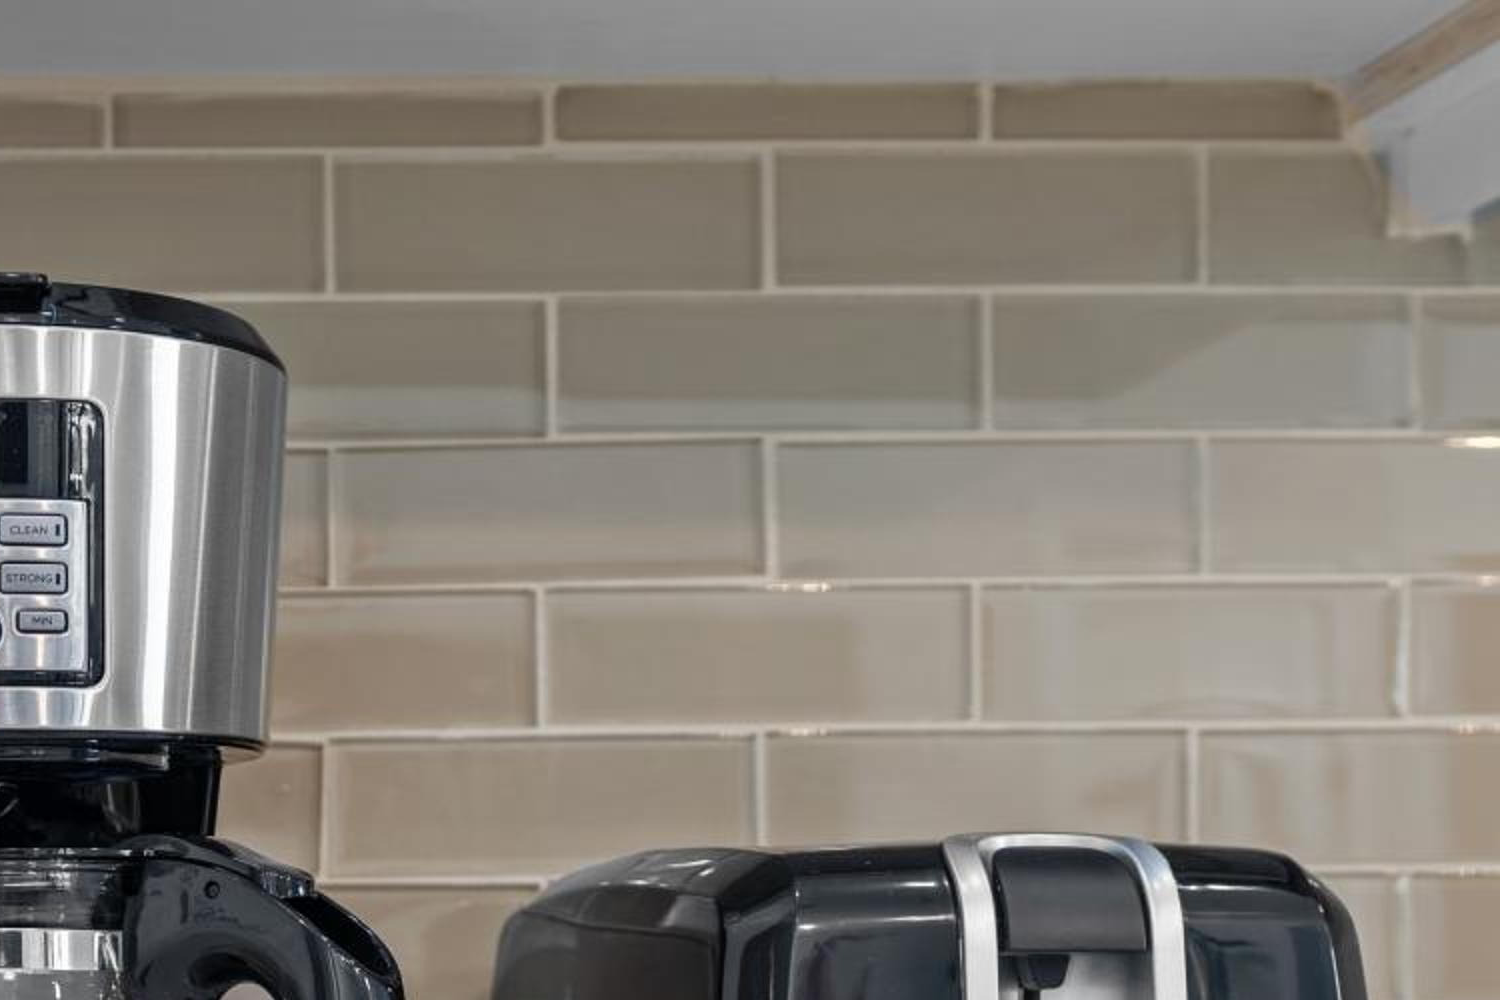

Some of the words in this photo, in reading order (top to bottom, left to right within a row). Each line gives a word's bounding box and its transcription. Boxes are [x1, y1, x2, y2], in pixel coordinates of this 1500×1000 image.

[9, 525, 48, 536] CLEAN
[5, 572, 53, 584] STRONG
[32, 615, 53, 626] MIN
